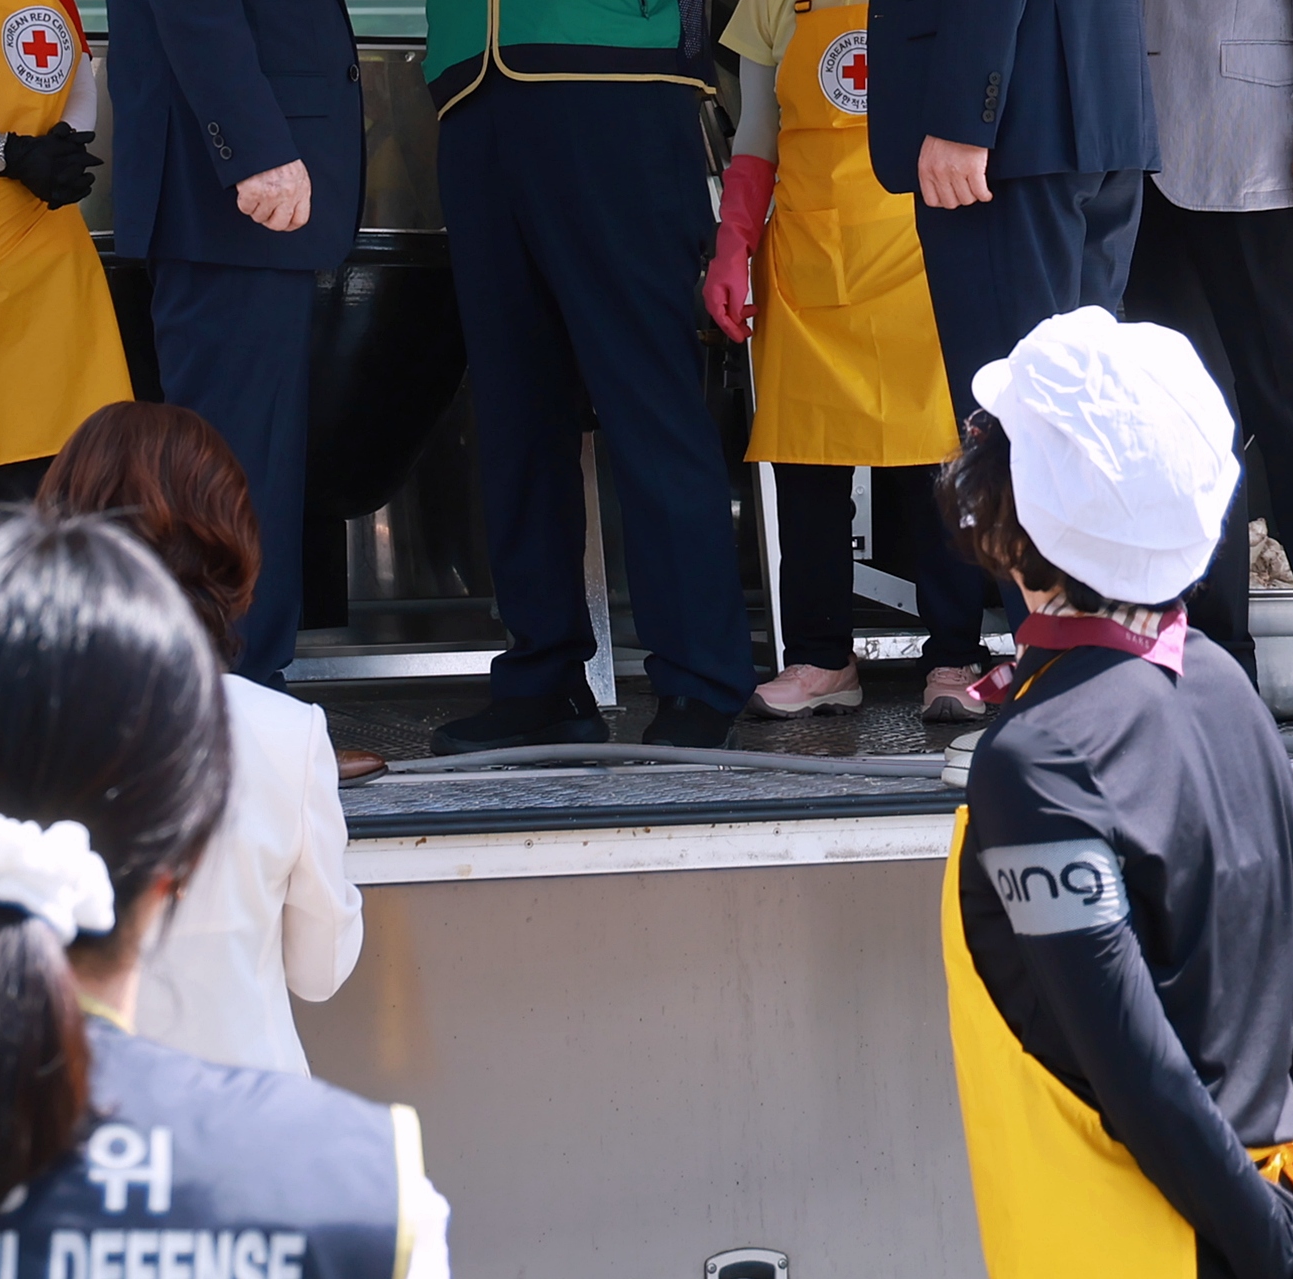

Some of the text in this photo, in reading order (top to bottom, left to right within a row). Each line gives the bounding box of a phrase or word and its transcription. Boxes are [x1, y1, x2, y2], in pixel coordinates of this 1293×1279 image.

[6, 12, 71, 51] KOREAN RED CROSS
[825, 38, 852, 73] KOREAN
